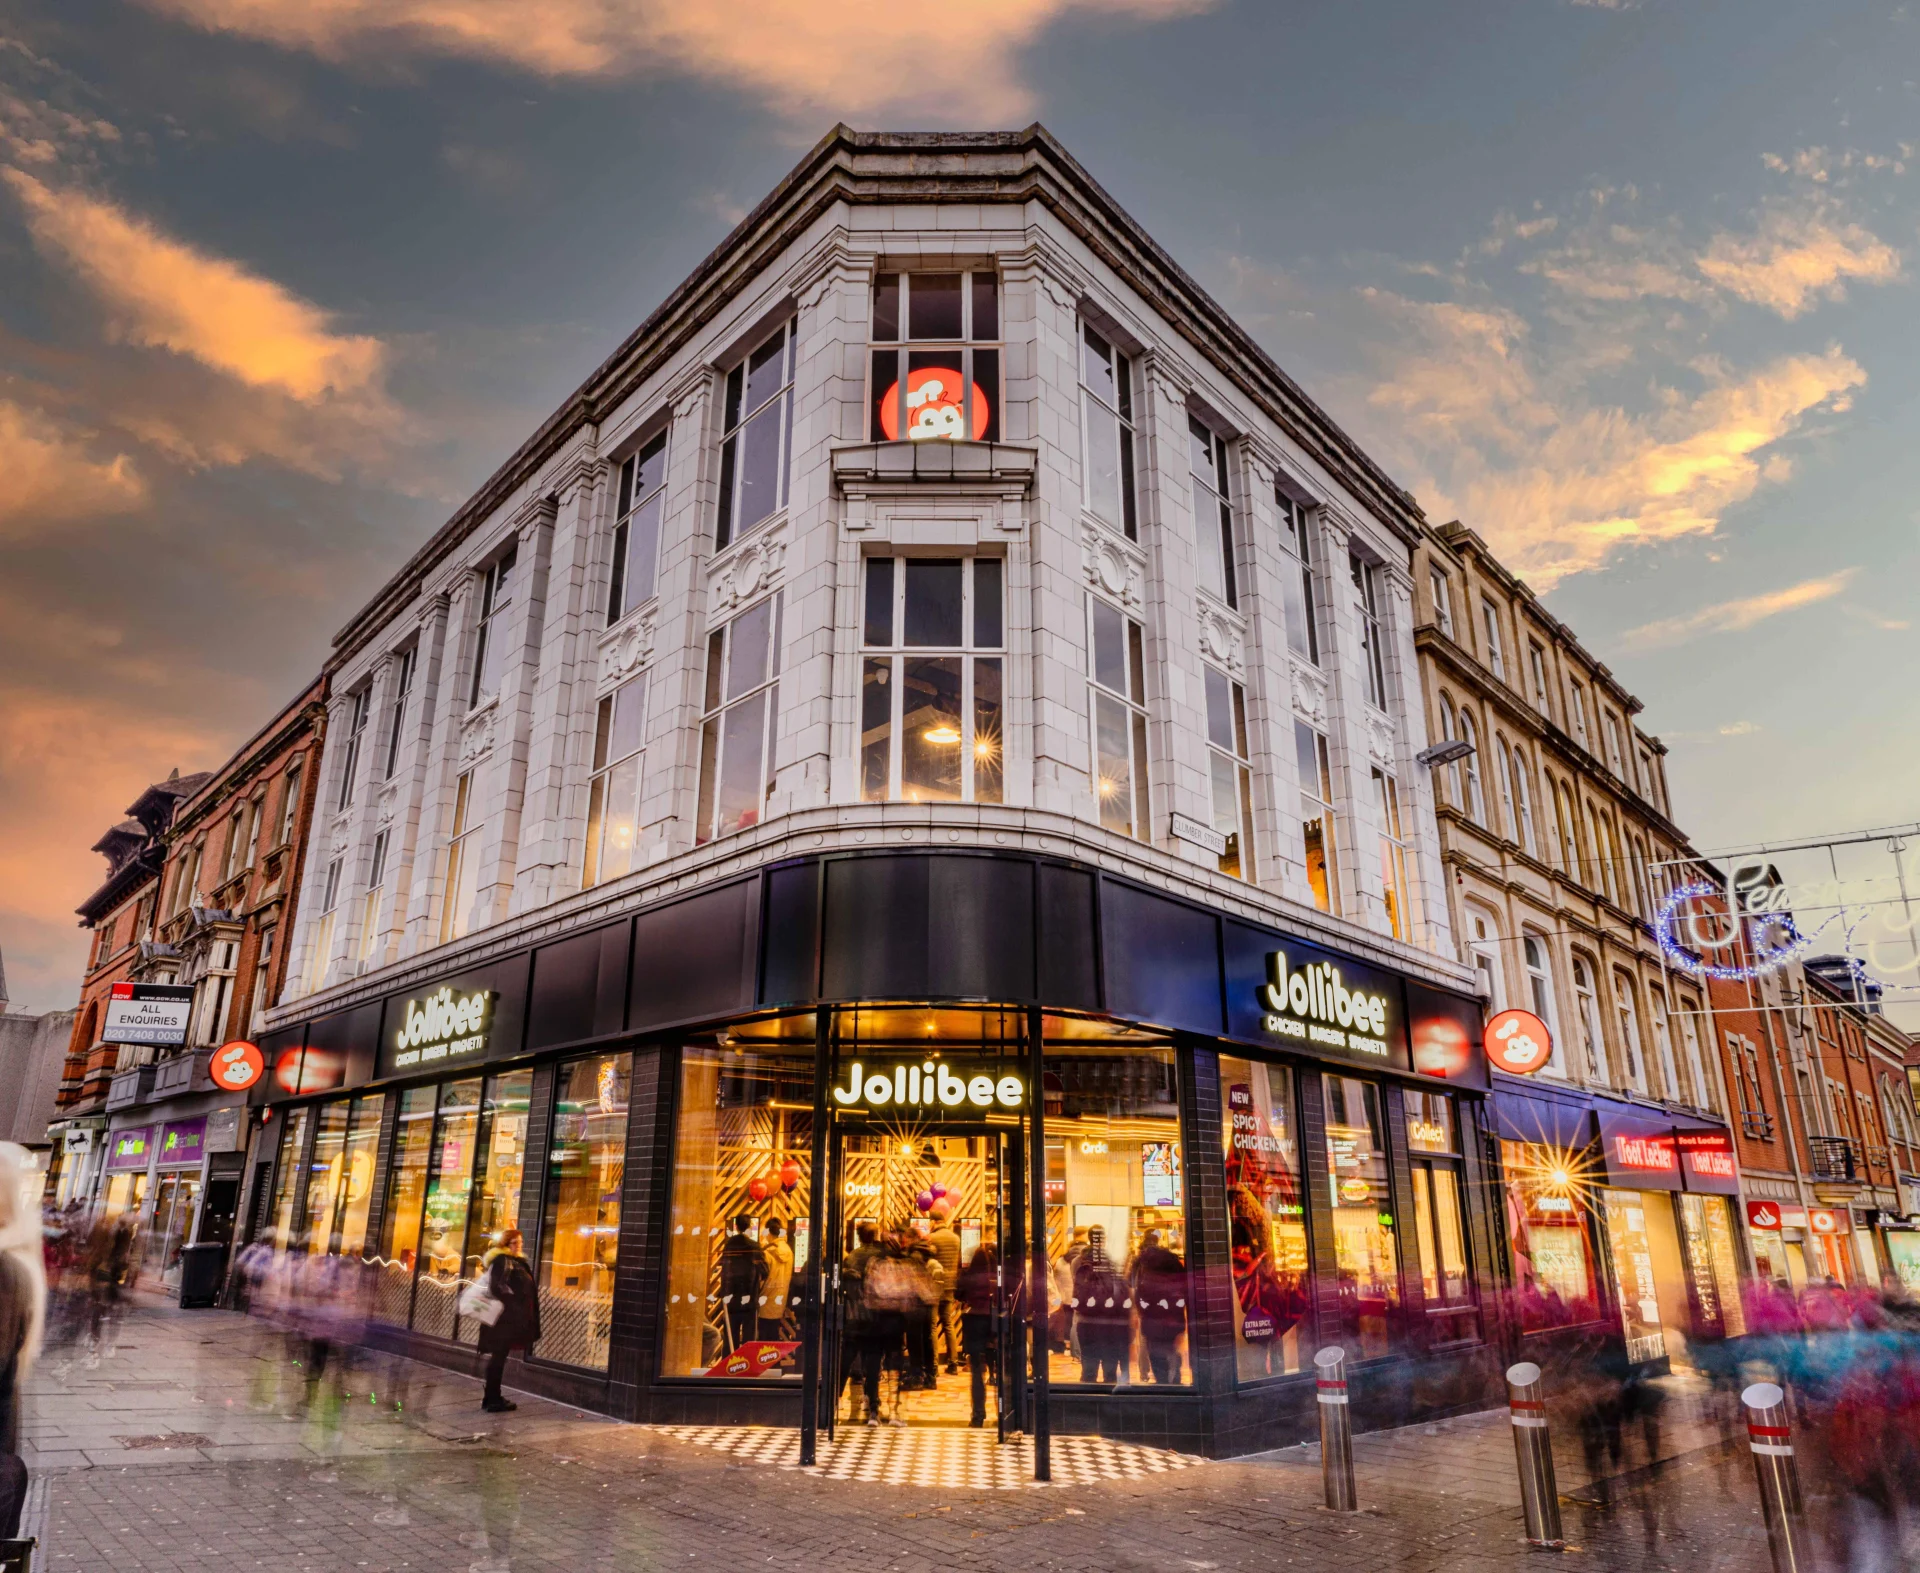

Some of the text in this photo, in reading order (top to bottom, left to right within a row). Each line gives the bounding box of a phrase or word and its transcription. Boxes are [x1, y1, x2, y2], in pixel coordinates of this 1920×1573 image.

[1174, 820, 1224, 850] CLUMBER STREET
[1268, 951, 1386, 1036] Jollibee
[140, 1004, 161, 1014] ALL
[119, 1014, 178, 1026] ENQUIRIES
[397, 986, 485, 1050] Jollibee
[104, 1029, 184, 1041] 020 7408 0030
[834, 1061, 1023, 1106] Jollibee
[1231, 1091, 1249, 1105] NEW
[1232, 1113, 1261, 1132] SPICY
[1411, 1120, 1445, 1143] Collect
[1233, 1133, 1293, 1153] CHICKENJOY
[1679, 1136, 1725, 1145] Foot Locker
[844, 1181, 883, 1197] Order
[1245, 1320, 1258, 1328] EXTRA
[1246, 1328, 1273, 1337] EXTRA CRISPY
[760, 1352, 777, 1362] spicy
[729, 1362, 747, 1372] spicy
